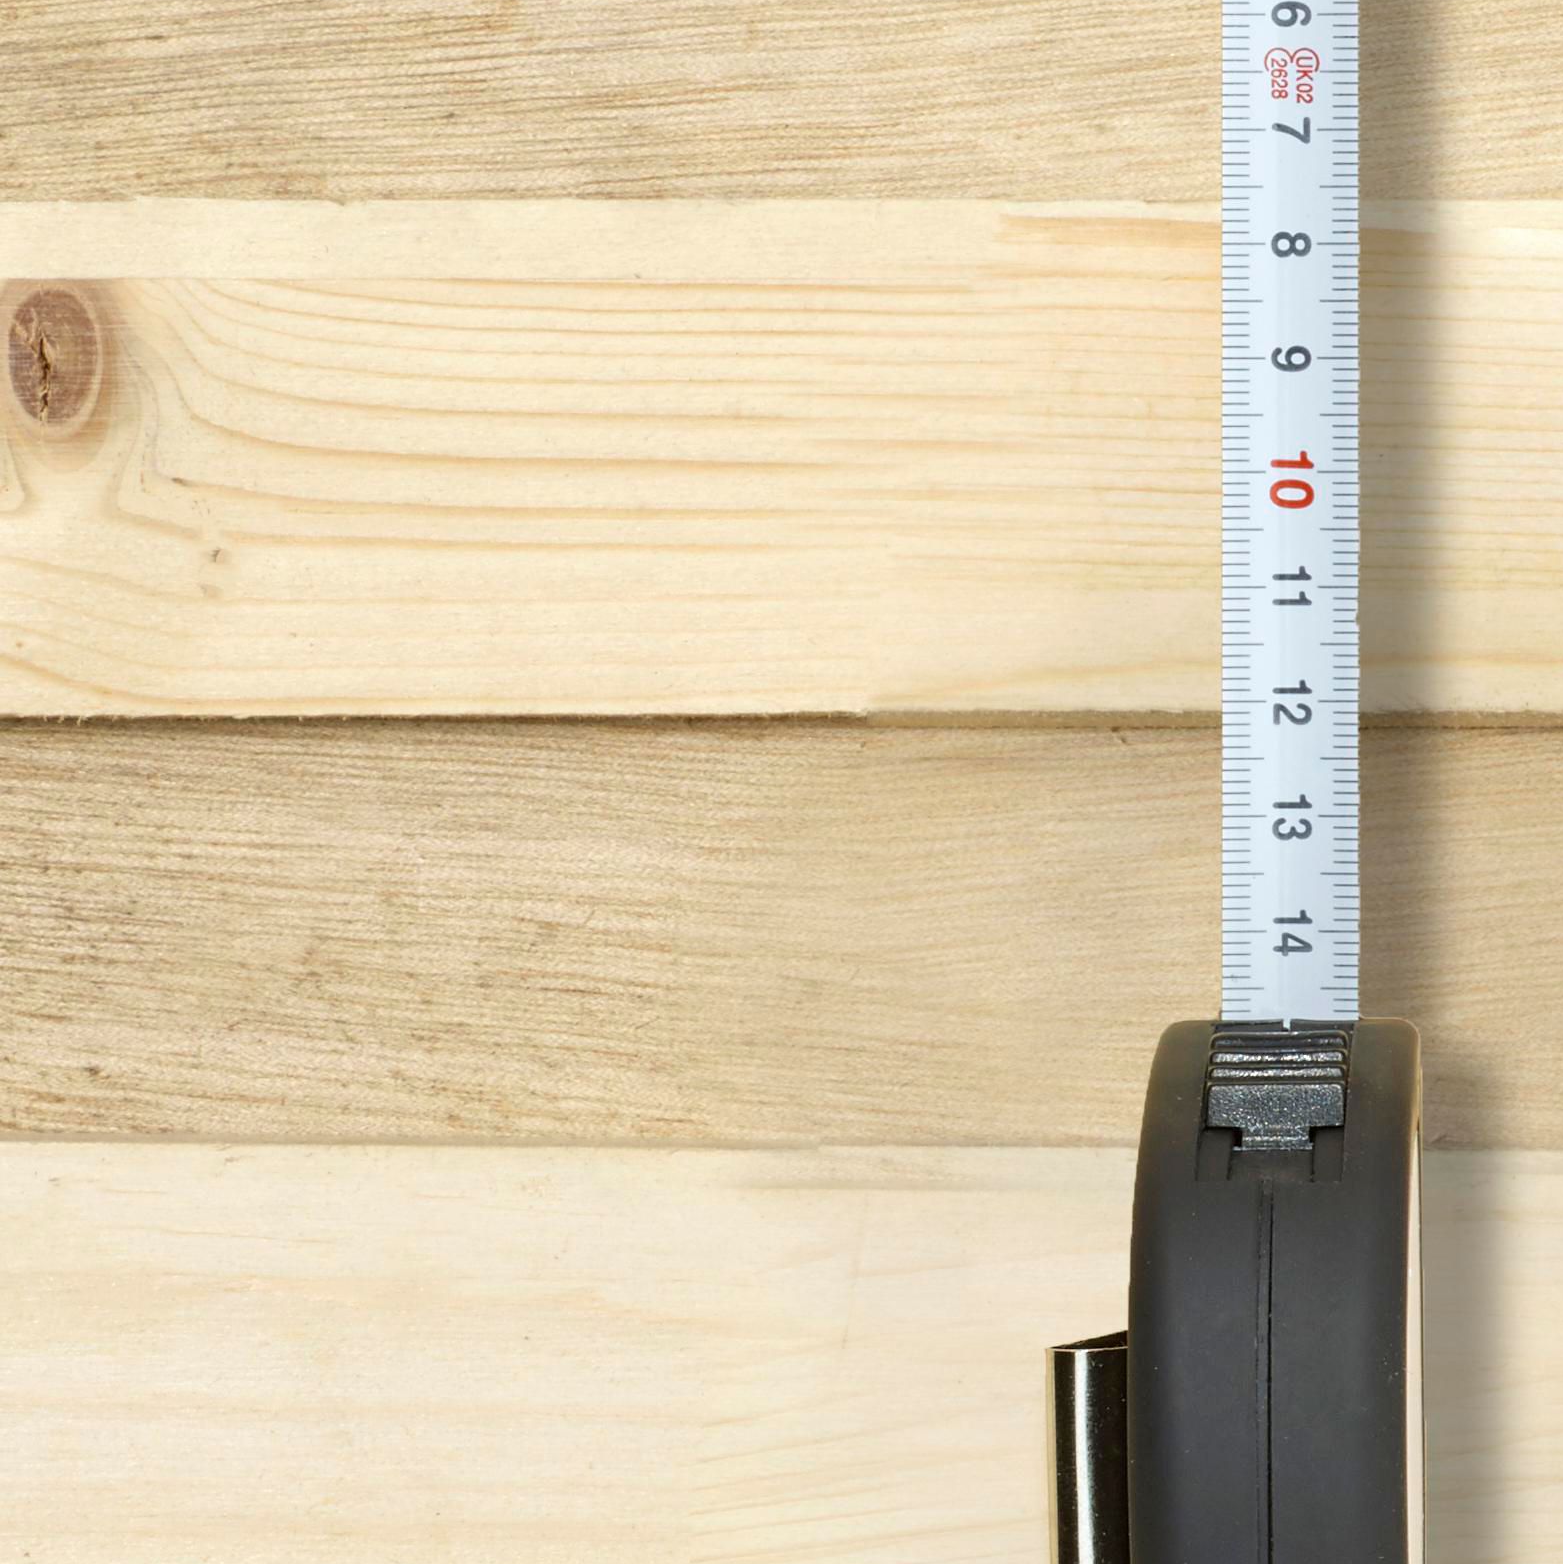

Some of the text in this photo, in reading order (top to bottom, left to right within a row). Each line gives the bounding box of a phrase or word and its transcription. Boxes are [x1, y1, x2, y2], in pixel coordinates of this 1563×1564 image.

[1271, 0, 1312, 28] 6
[1270, 57, 1289, 100] 2628
[1295, 56, 1314, 104] UK02
[1271, 116, 1311, 144] 7
[1271, 231, 1312, 258] 8
[1271, 345, 1312, 373] 9
[1269, 449, 1315, 511] 10
[1272, 565, 1313, 606] 11
[1272, 679, 1313, 726] 12
[1272, 793, 1313, 841] 13
[1272, 909, 1313, 957] 14
